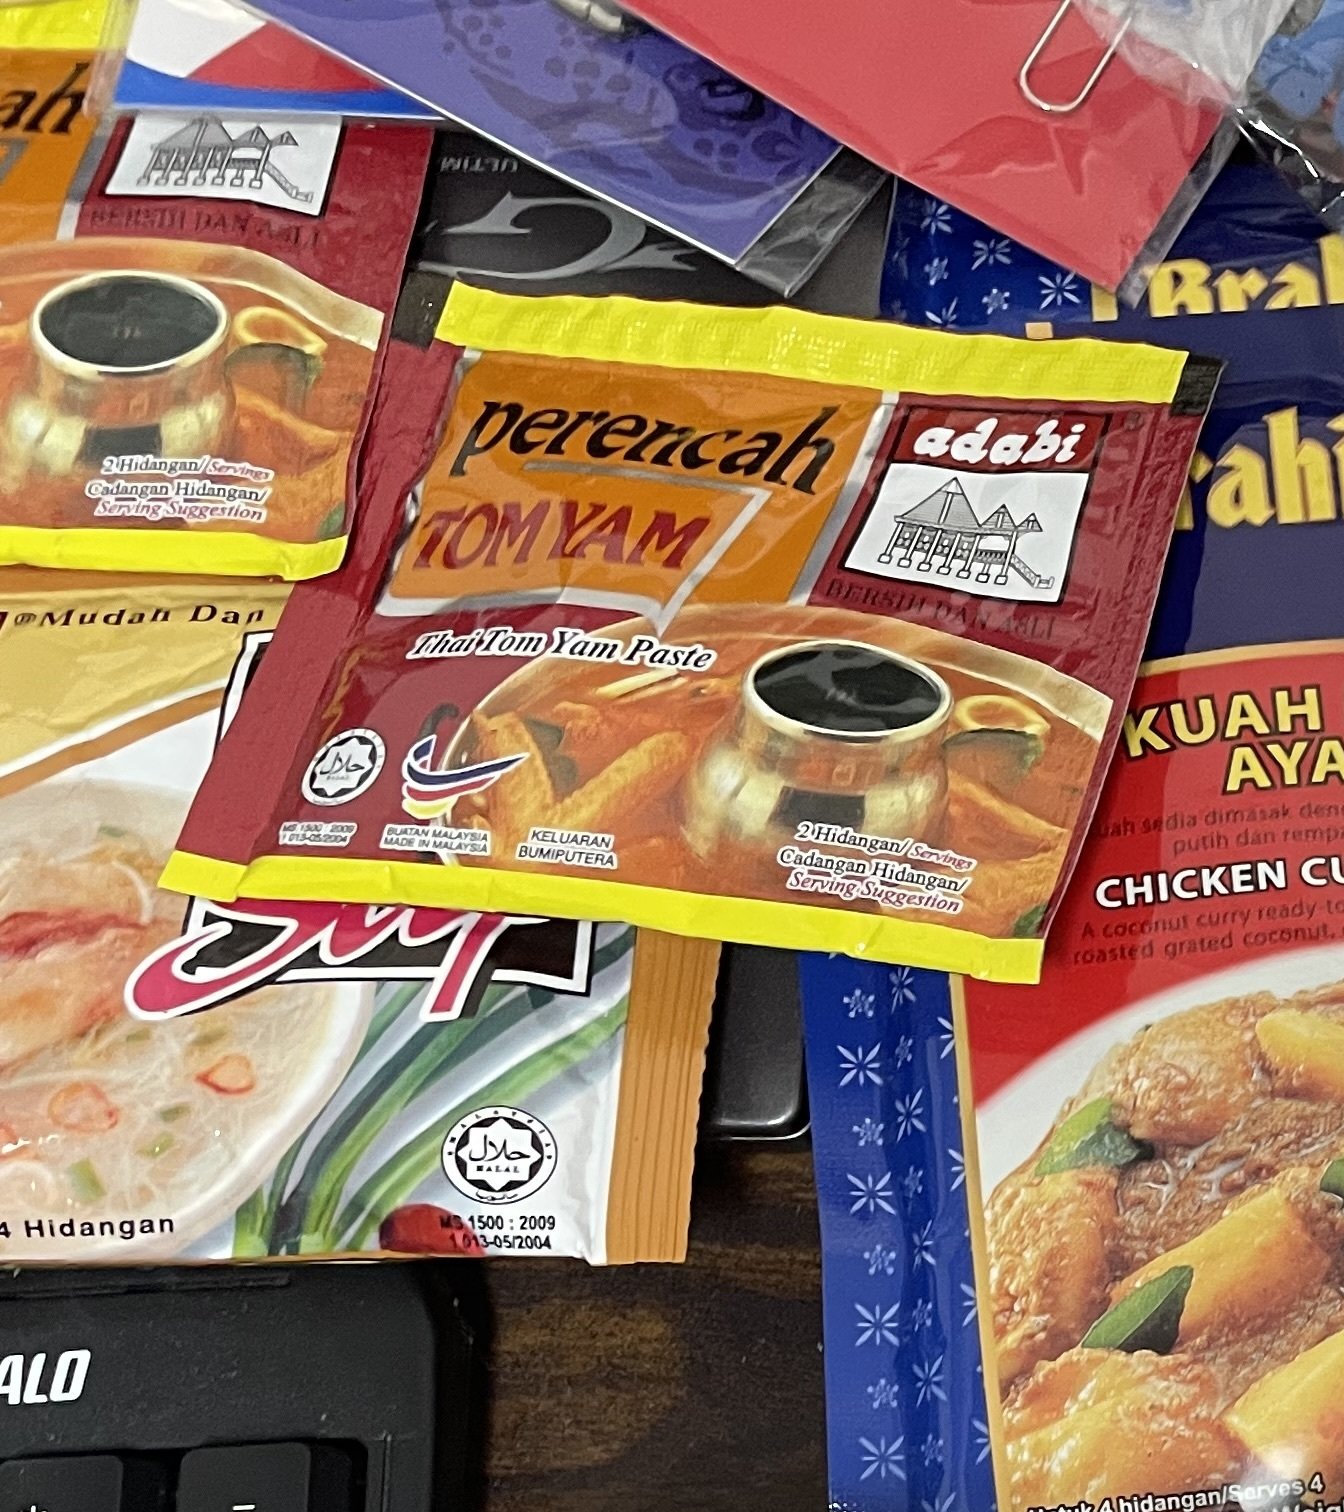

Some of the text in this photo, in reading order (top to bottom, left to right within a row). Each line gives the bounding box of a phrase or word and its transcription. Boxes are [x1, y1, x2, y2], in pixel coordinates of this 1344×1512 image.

[449, 399, 837, 496] perencah
[913, 416, 1085, 466] adabi
[87, 481, 168, 499] Cadangan
[98, 501, 265, 523] Serving Suggestion
[412, 499, 710, 572] TOM YAM
[40, 603, 266, 628] Mudah Dan
[413, 629, 714, 671] Thai Tom Yam Paste
[1125, 686, 1324, 758] KUAH
[383, 836, 417, 848] MADE
[431, 839, 488, 854] MALAYSIA
[431, 828, 488, 843] MALAYSIA
[530, 829, 614, 851] KELUARAN
[796, 823, 974, 870] 2 Hidangan/ Servings
[1172, 827, 1230, 856] putih
[1235, 825, 1276, 848] dan
[518, 845, 618, 869] BUMIPUTERA
[779, 847, 969, 892] Cadangan Hidangan/
[789, 871, 961, 913] Serving Suggestion
[1094, 857, 1288, 909] CHICKEN
[1102, 914, 1191, 940] coconut
[1196, 906, 1252, 934] curry
[1072, 941, 1155, 966] roasted
[1164, 931, 1234, 961] grated
[24, 1217, 175, 1241] Hidangan
[467, 1214, 505, 1231] 1500
[518, 1214, 557, 1231] 2009
[1308, 1472, 1324, 1494] 4
